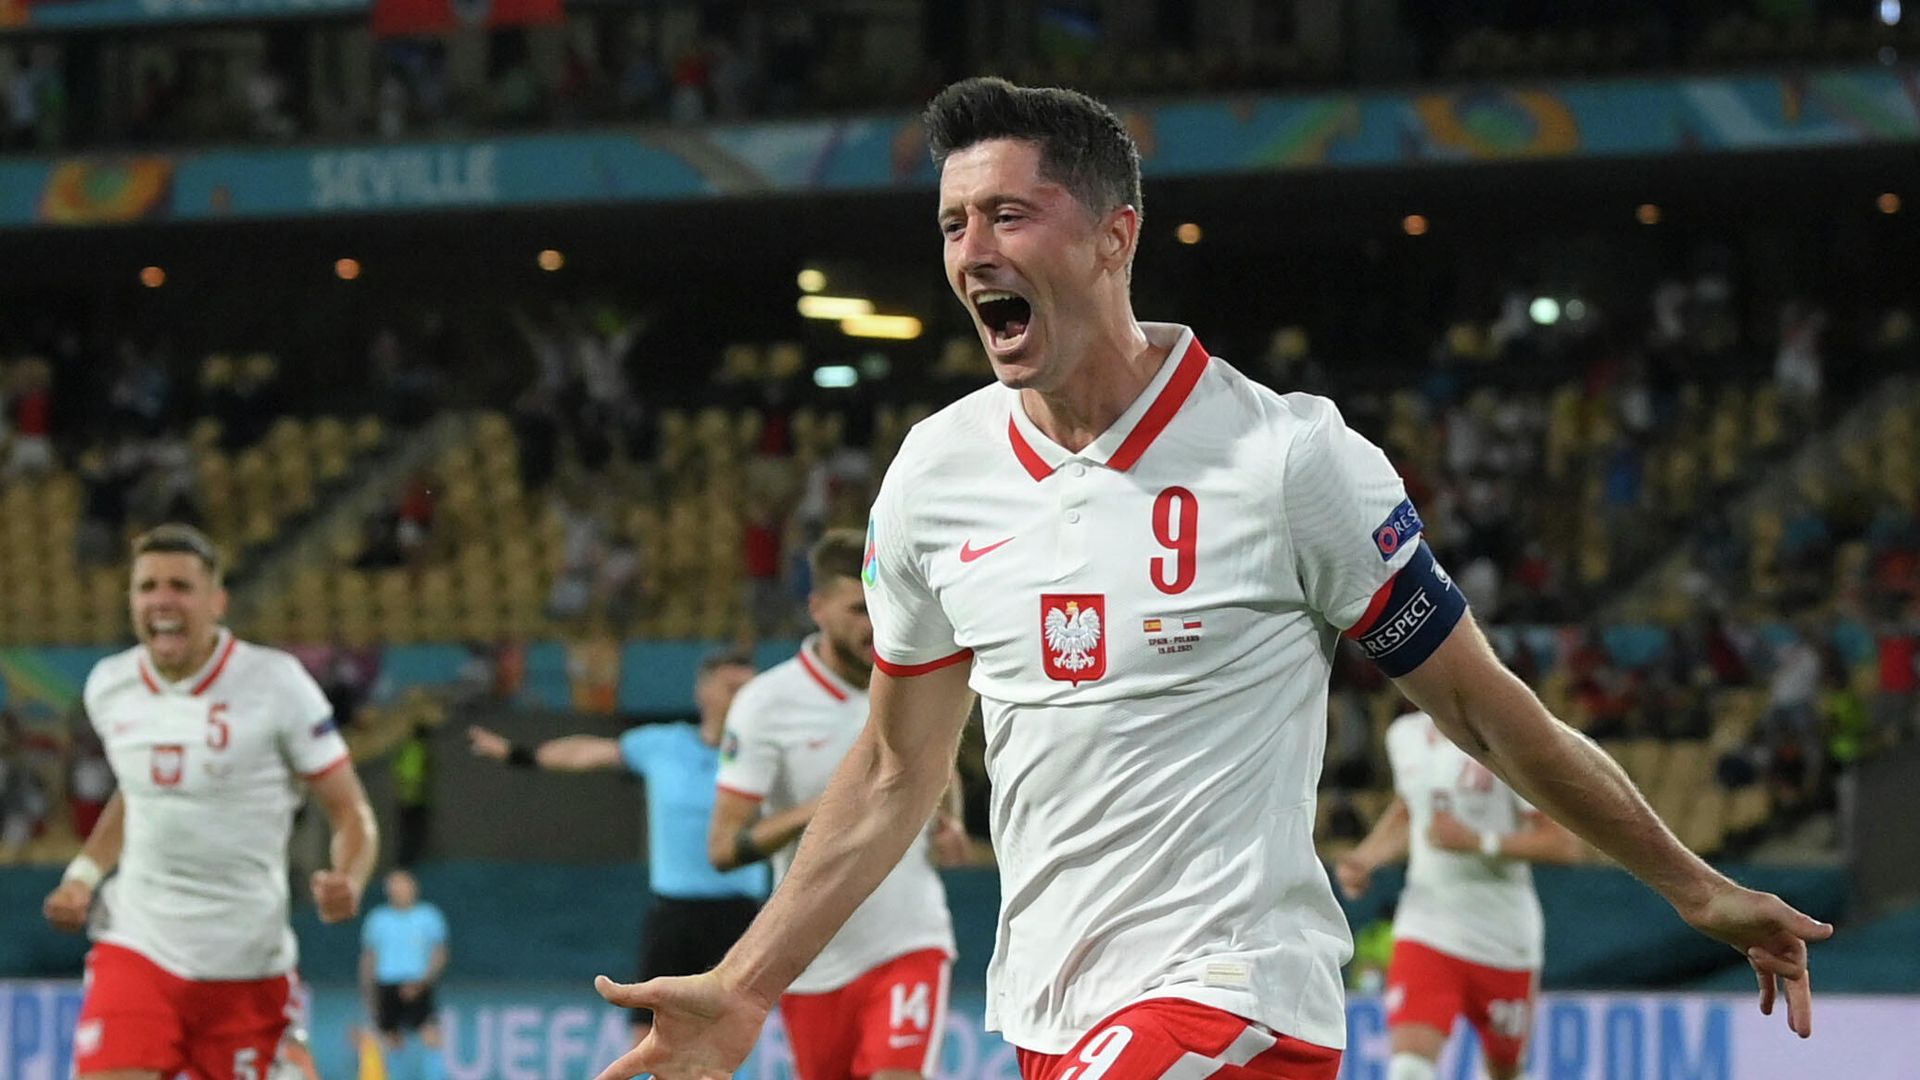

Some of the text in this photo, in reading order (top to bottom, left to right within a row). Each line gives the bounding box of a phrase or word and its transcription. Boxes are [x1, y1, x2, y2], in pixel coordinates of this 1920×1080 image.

[311, 146, 495, 208] SEVILLE
[1150, 485, 1198, 595] 9
[1174, 634, 1200, 644] POLAND
[1366, 592, 1432, 654] RESPECT
[207, 702, 230, 752] 5
[890, 982, 929, 1031] 14
[440, 1006, 634, 1080] UEFA
[1056, 1024, 1134, 1080] 9
